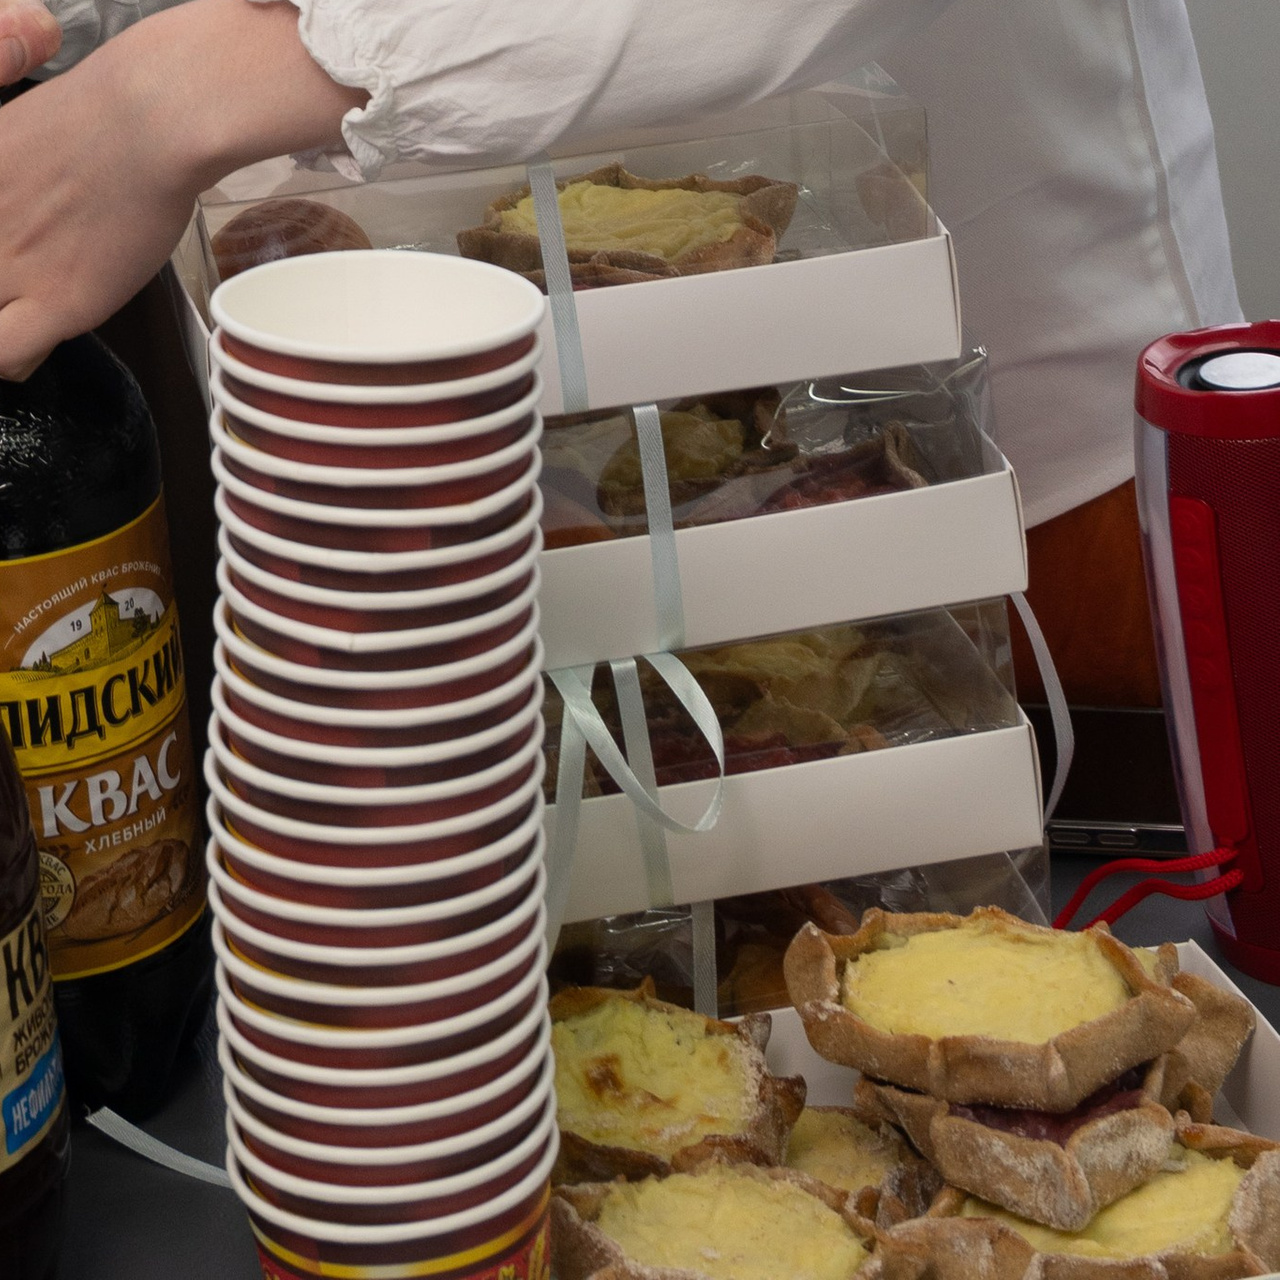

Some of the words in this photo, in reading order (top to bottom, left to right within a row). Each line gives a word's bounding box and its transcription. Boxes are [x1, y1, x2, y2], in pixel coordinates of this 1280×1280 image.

[13, 578, 89, 635] НАСТОЯЩИЙ
[90, 565, 119, 585] КВАС
[70, 619, 83, 633] 19
[124, 597, 135, 612] 20
[37, 731, 181, 838] КВАС
[85, 805, 167, 854] ХЛЕБНЫЙ
[2, 909, 49, 1021] КВ
[12, 996, 53, 1052] ЖИВО
